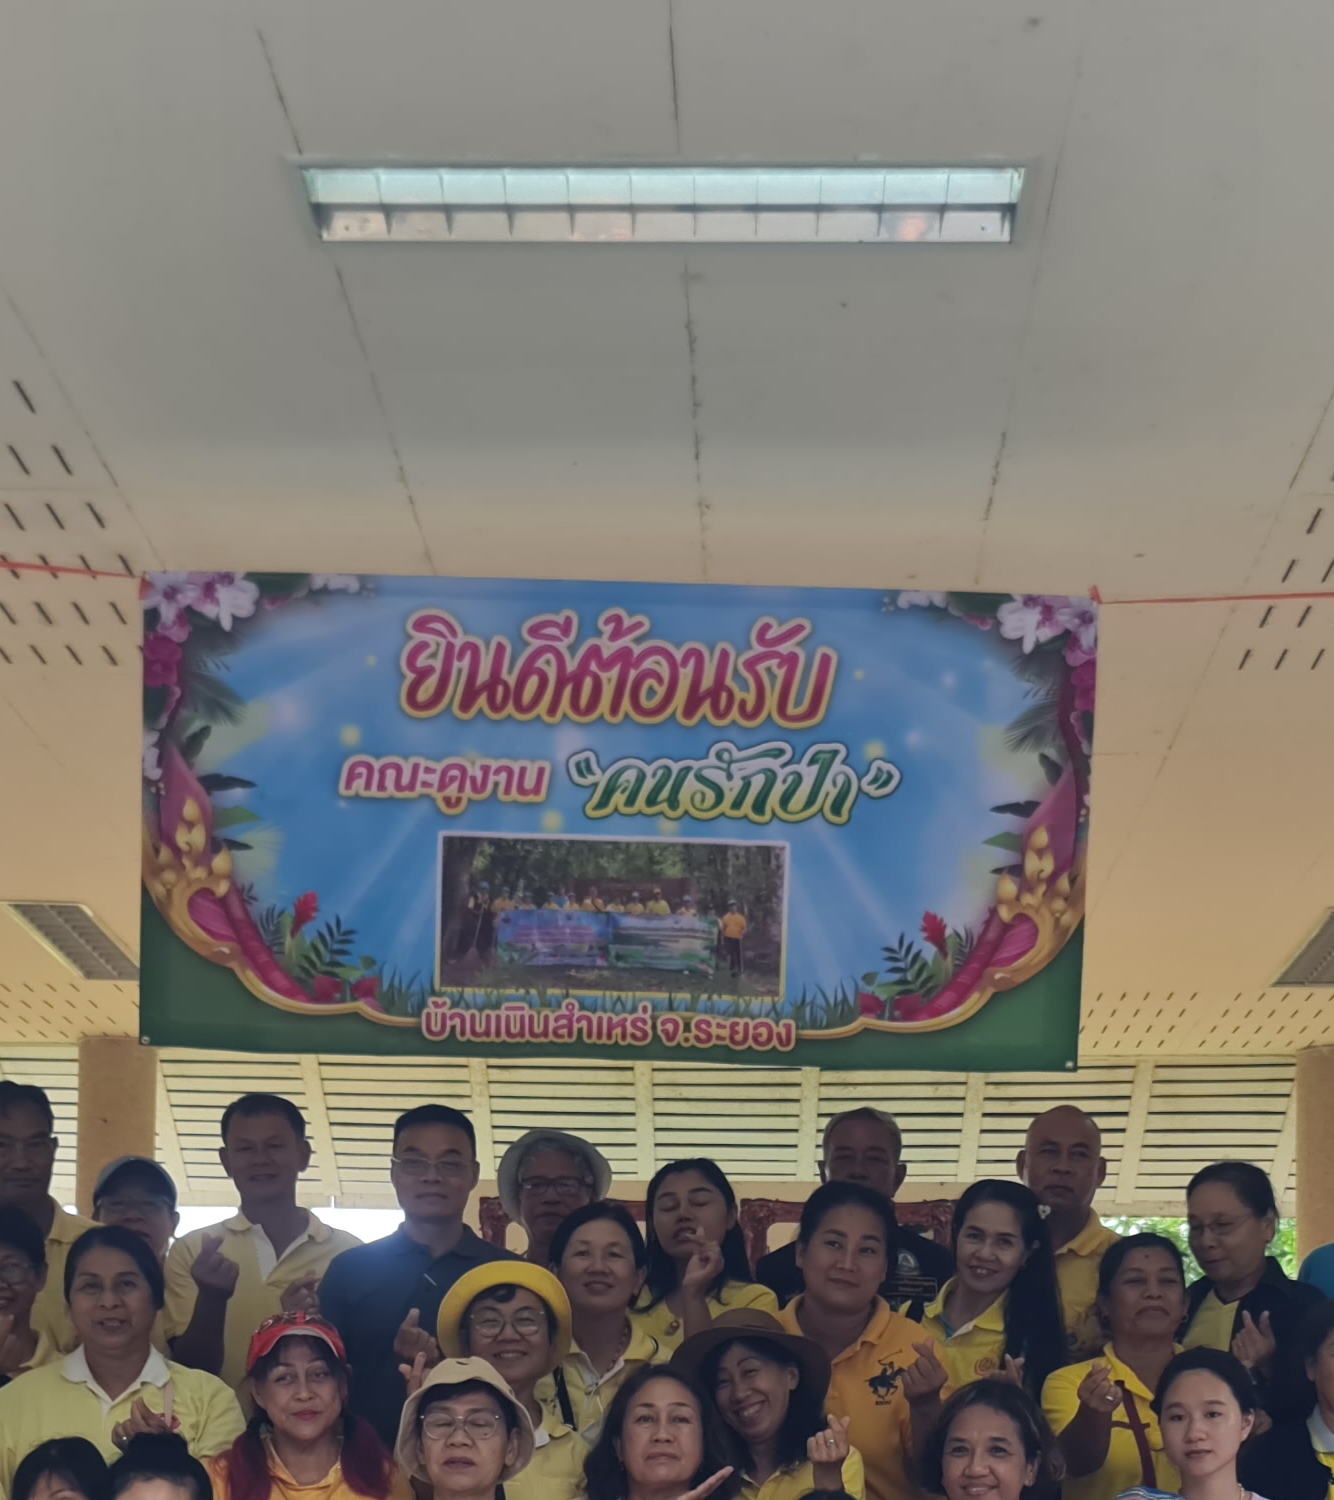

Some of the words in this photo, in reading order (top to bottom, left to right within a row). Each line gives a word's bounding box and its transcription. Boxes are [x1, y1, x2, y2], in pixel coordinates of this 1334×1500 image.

[403, 609, 836, 726] ยินดีต้อนรับ
[341, 755, 548, 814] คณะดูงาน
[424, 1000, 651, 1044] บ้านเนินสำเหร่
[660, 1015, 794, 1048] จ.ระยอง
